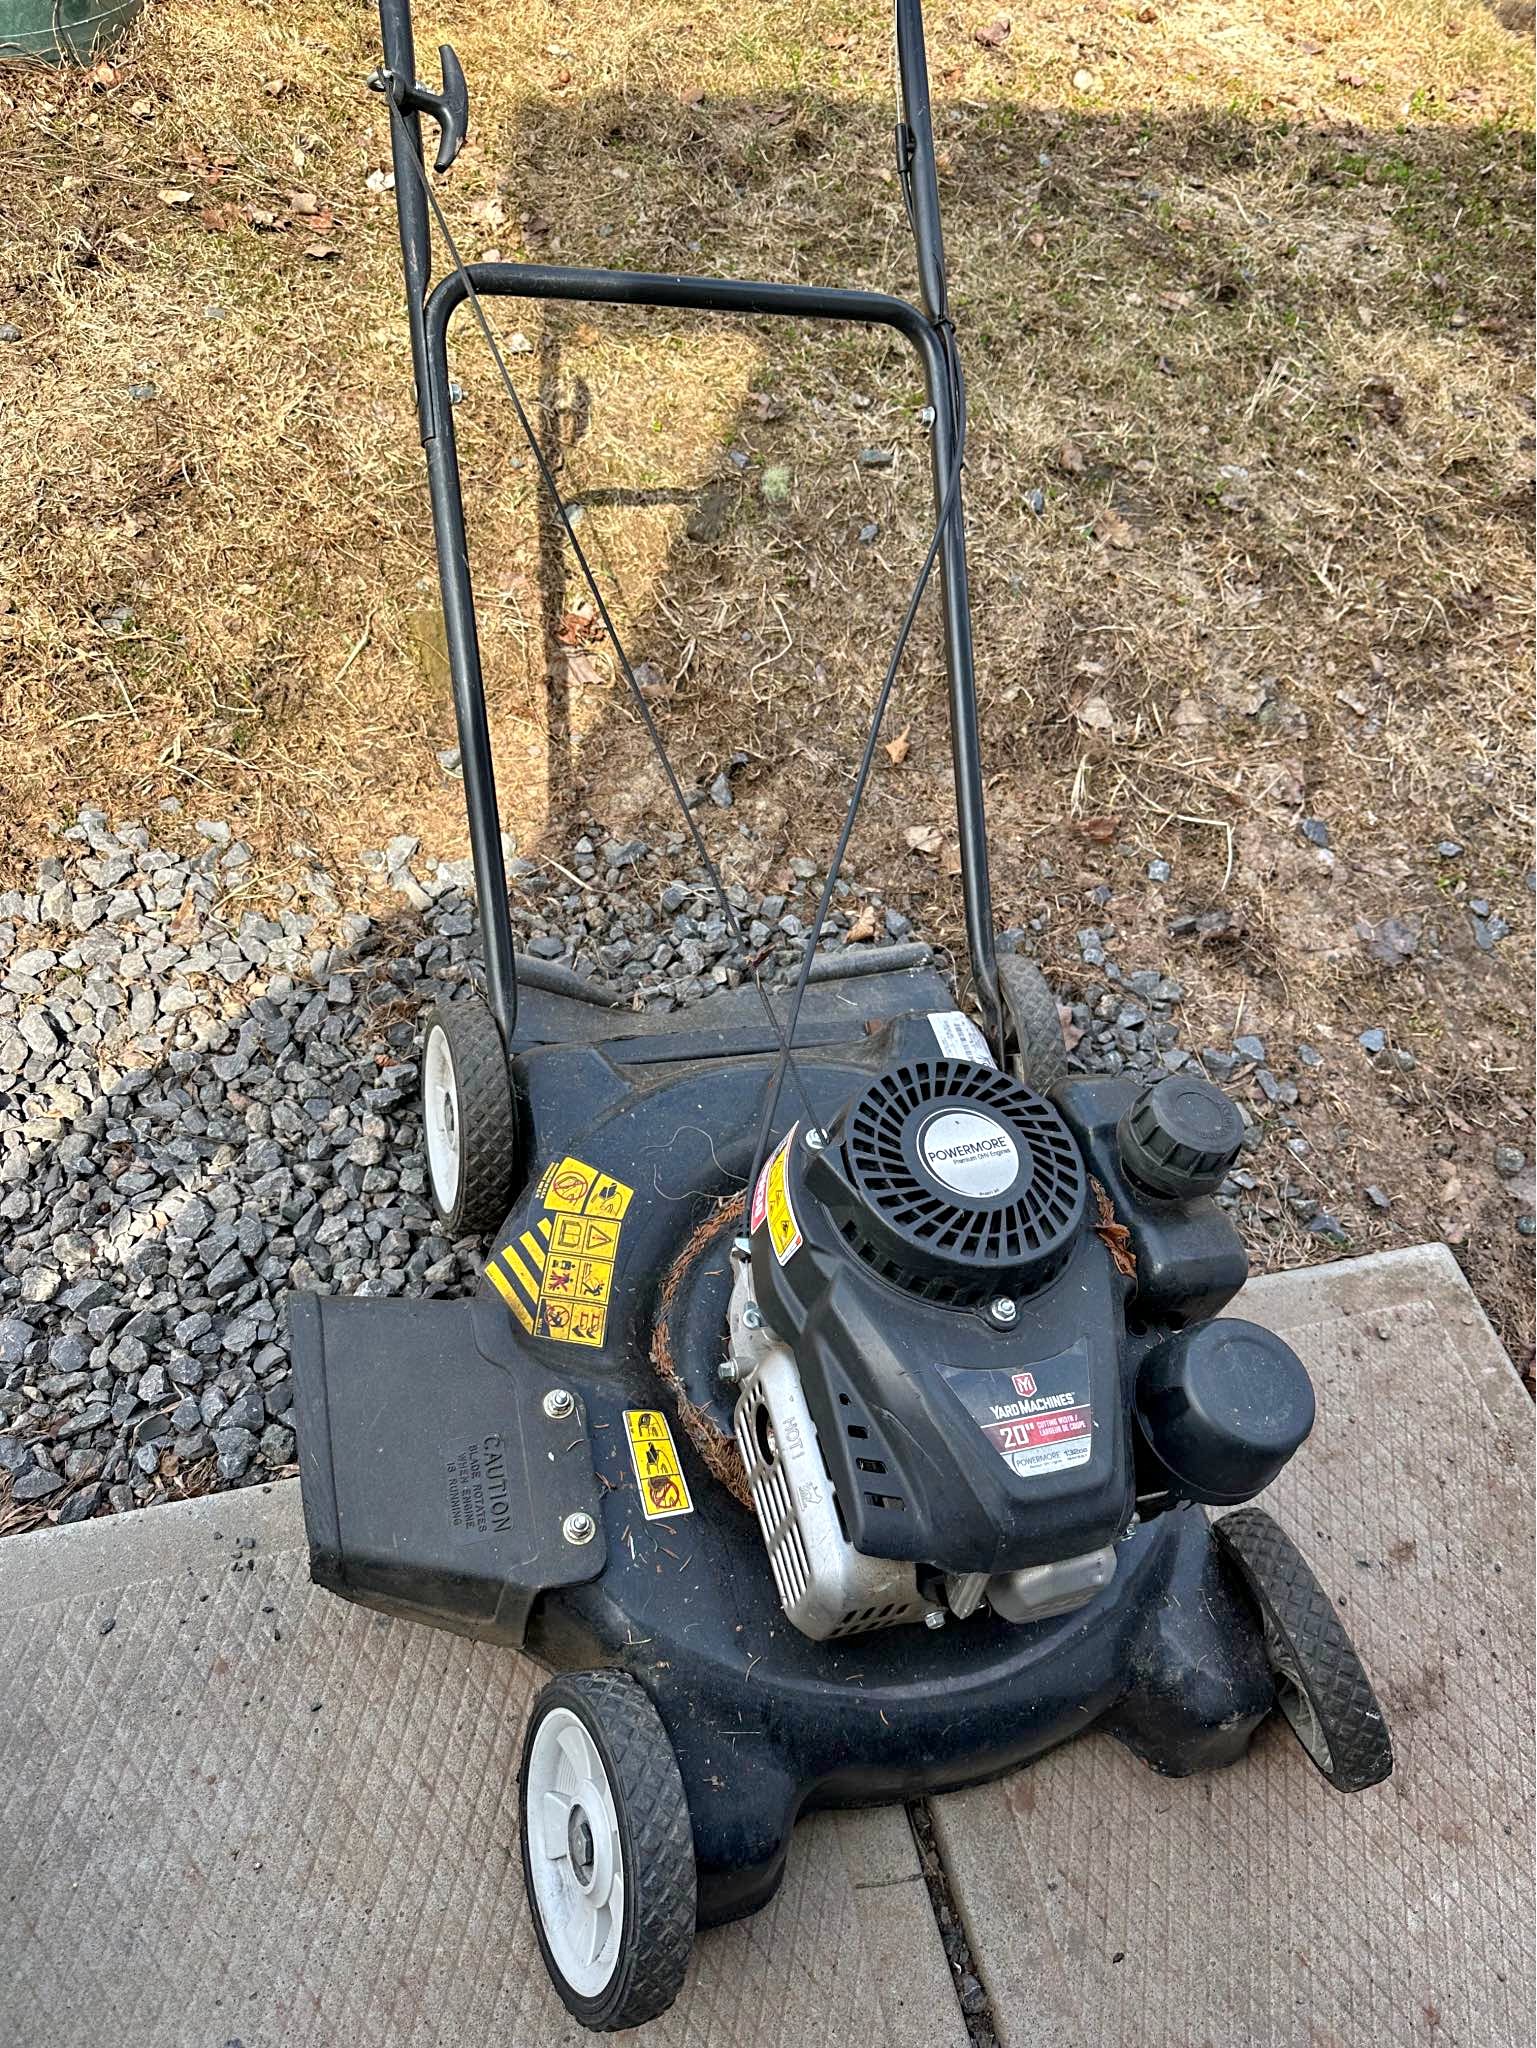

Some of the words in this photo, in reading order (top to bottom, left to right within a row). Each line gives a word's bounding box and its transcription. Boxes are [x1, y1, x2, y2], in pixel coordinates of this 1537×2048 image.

[928, 1137, 1006, 1162] POWERMORE
[446, 1462, 456, 1473] IS
[457, 1452, 469, 1484] WHEN
[468, 1444, 481, 1480] BLADE
[1016, 1451, 1061, 1466] POWERMORE
[448, 1478, 462, 1526] RUNNING
[484, 1435, 512, 1533] CAUTION
[462, 1488, 475, 1529] ENGINE
[472, 1484, 487, 1533] ROTATES
